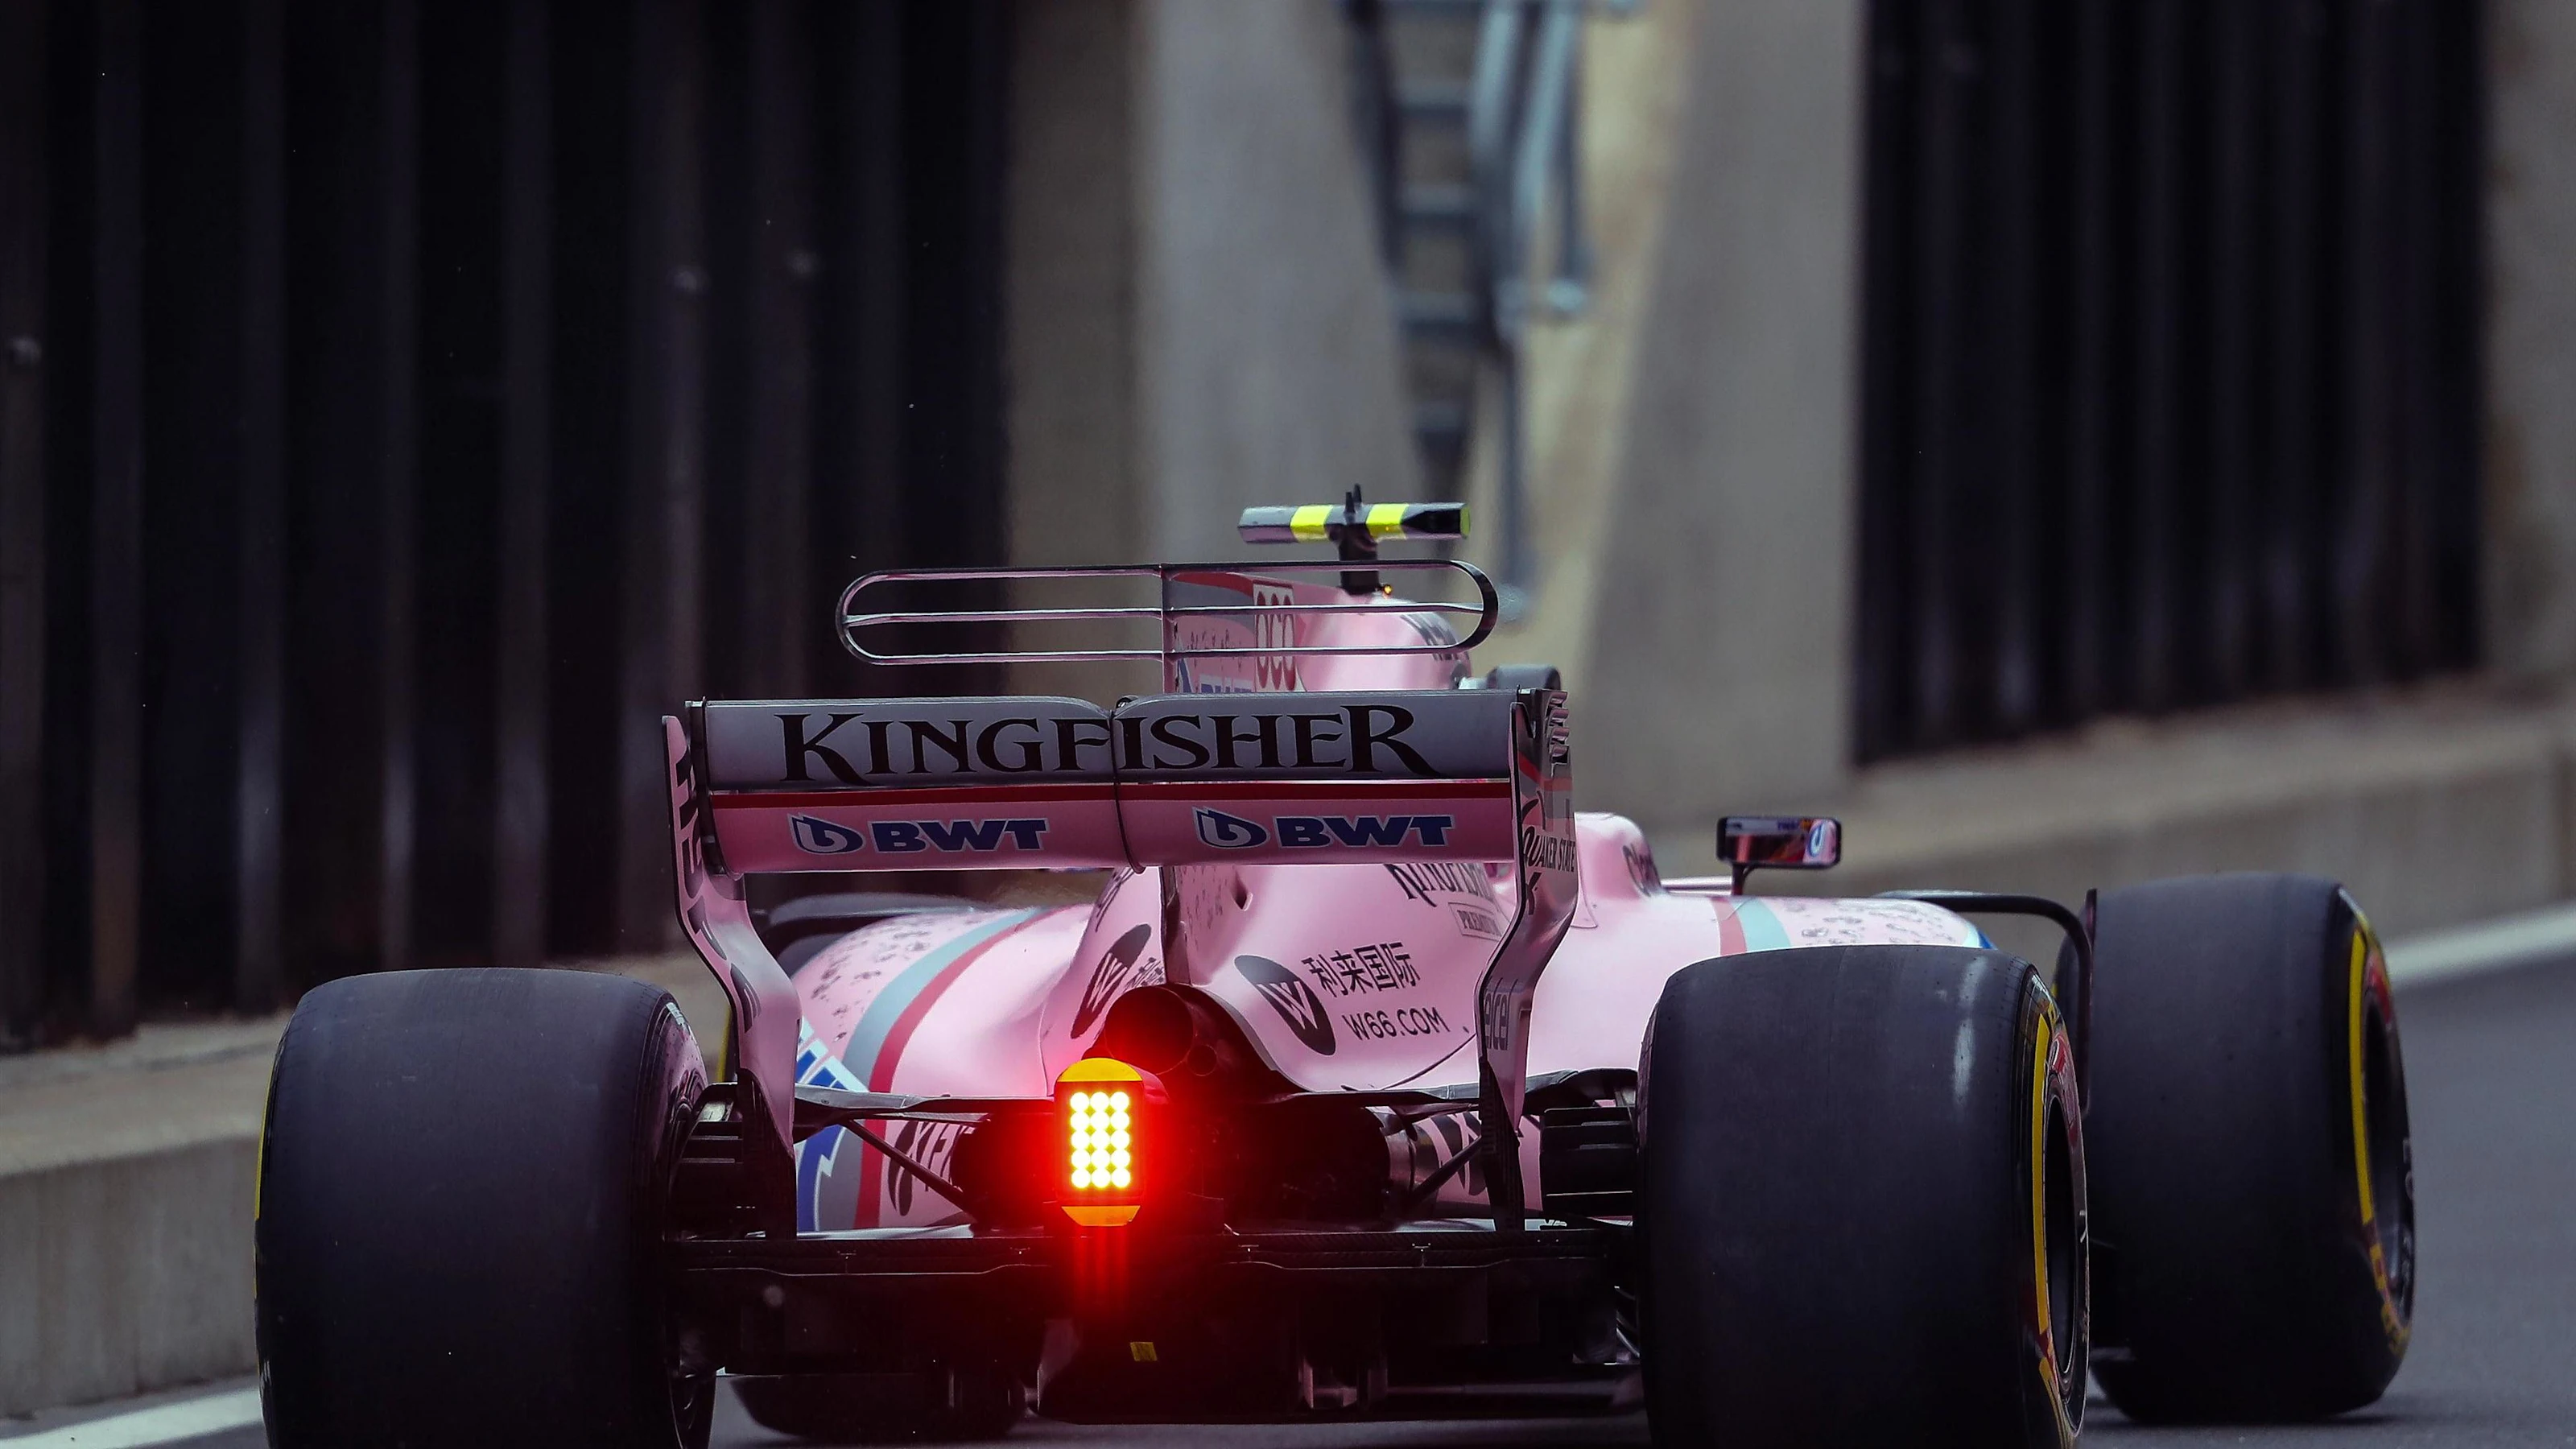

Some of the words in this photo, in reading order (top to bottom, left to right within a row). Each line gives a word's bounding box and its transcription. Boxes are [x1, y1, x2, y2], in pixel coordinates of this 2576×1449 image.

[774, 705, 1441, 786] KINGFISHER
[872, 818, 1047, 852] BWT
[1275, 814, 1452, 848] BWT
[1523, 826, 1557, 871] QUAKER
[1302, 942, 1422, 997] 利来国际
[1343, 1007, 1451, 1041] W66.COM
